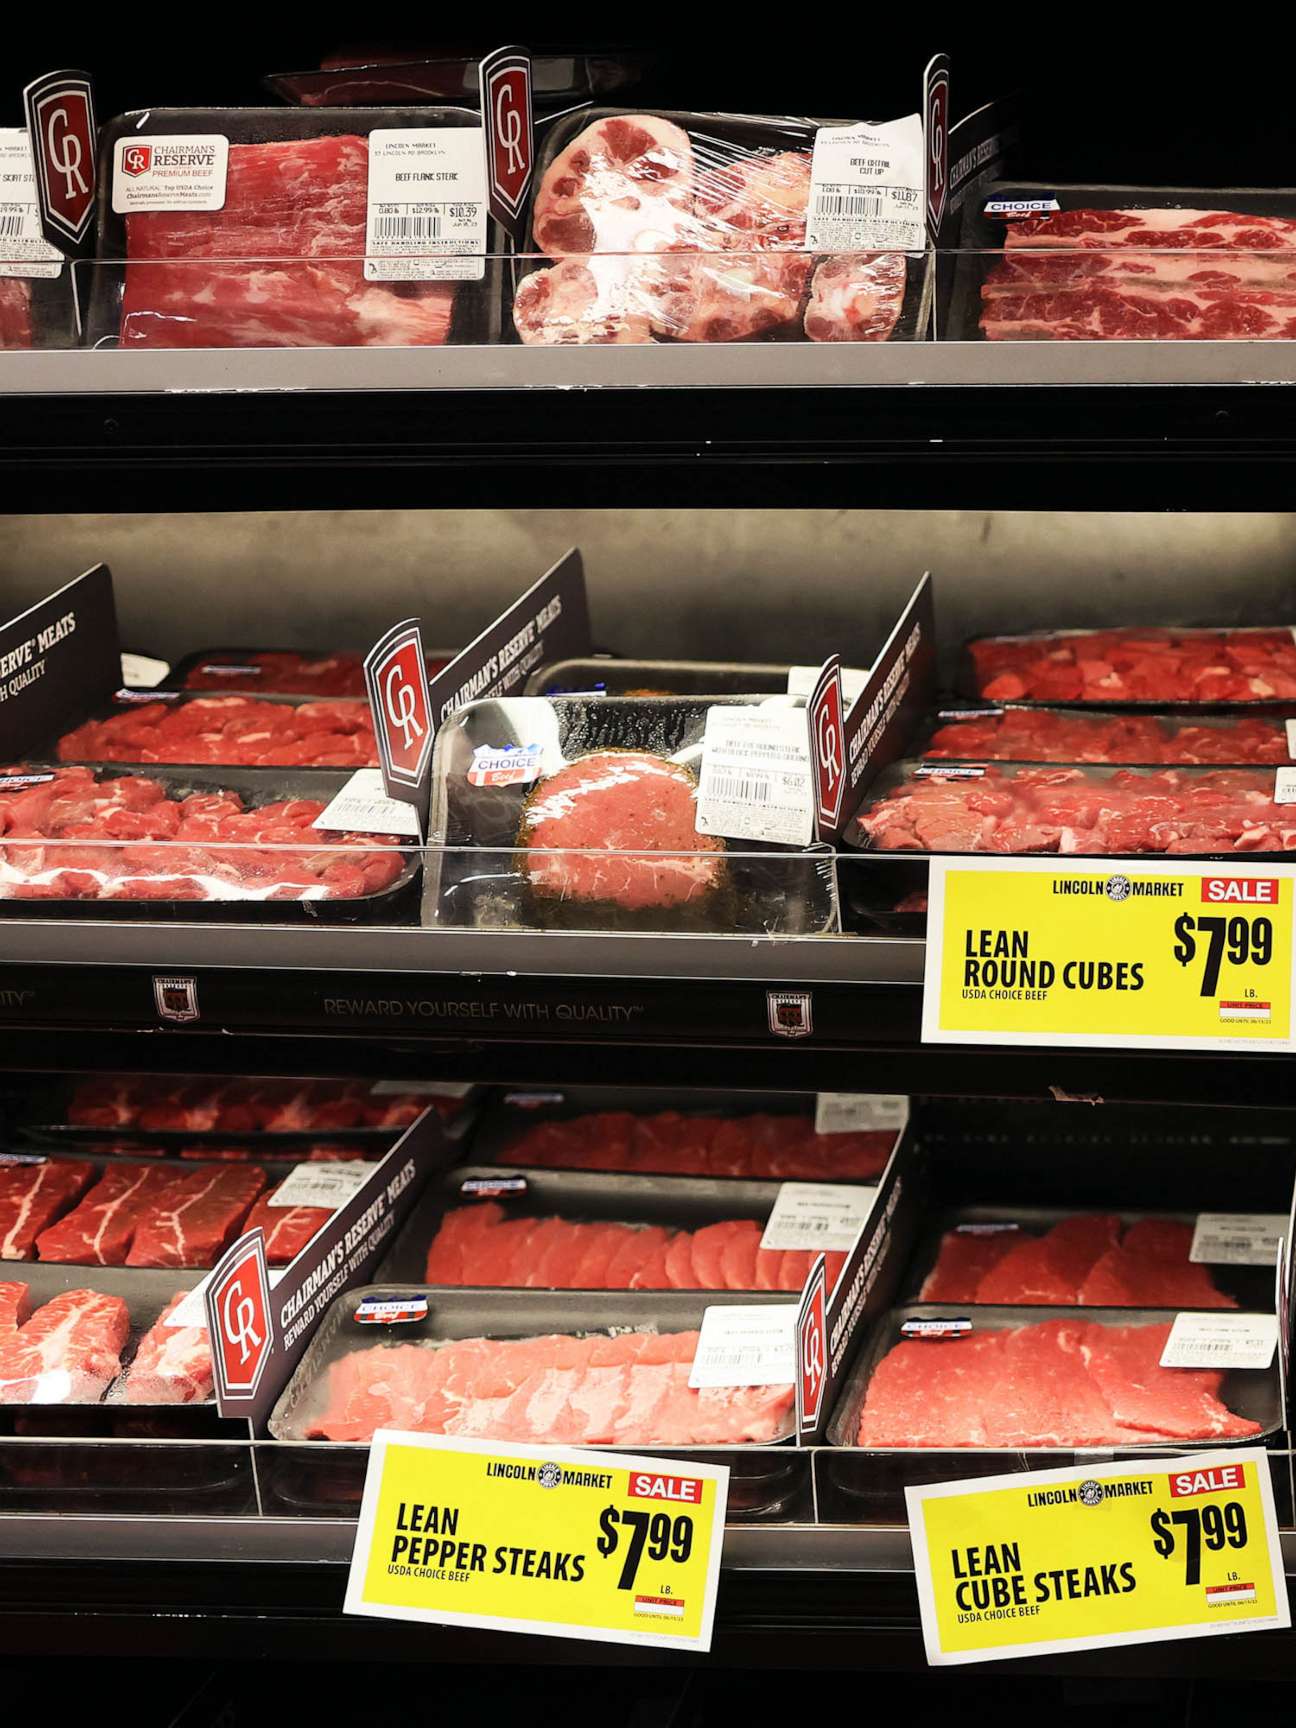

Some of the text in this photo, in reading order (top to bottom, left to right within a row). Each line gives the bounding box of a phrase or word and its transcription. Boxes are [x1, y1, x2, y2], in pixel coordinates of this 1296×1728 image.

[127, 149, 145, 169] CR
[153, 155, 216, 166] RESERVE
[154, 146, 215, 154] CHAIRMAN'S
[395, 173, 459, 181] BEEF FLANK STEAK
[450, 207, 477, 217] $10.39
[991, 202, 1052, 210] CHOICE
[37, 612, 76, 653] MEATS
[9, 659, 46, 697] QUALITY
[441, 656, 498, 722] CHAIRMAN'S
[479, 757, 536, 770] CHOICE
[1053, 880, 1104, 895] LINCOLN
[1132, 883, 1184, 897] MARKET
[1208, 880, 1272, 903] SALE
[965, 930, 1029, 958] LEAN
[964, 959, 1144, 991] ROUND CUBES
[962, 989, 1047, 1001] USDA CHOICE BEEF
[1244, 989, 1258, 998] LB.
[323, 999, 402, 1016] REWARD
[408, 1000, 499, 1017] YOURSELF
[504, 1002, 550, 1019] WITH
[280, 1158, 416, 1328] CHAIRMAN'S RESERVE MEATS
[284, 1306, 316, 1351] REWARD
[315, 1265, 350, 1317] YOURSELF
[349, 1242, 368, 1272] WITH
[487, 1462, 536, 1481] LINCOLN
[563, 1471, 613, 1489] MARKET
[1176, 1467, 1239, 1497] SALE
[635, 1475, 696, 1501] SALE
[1028, 1491, 1077, 1508] LINCOLN
[1104, 1480, 1153, 1497] MARKET
[396, 1502, 459, 1536] LEAN
[391, 1535, 586, 1582] PEPPER STEAKS
[951, 1542, 1021, 1579] LEAN
[387, 1564, 470, 1582] USDA CHOICE BEEF
[1227, 1571, 1240, 1581] LB.
[660, 1585, 673, 1595] LB.
[955, 1562, 1136, 1612] CUBE STEAKS
[958, 1605, 1040, 1623] USDA CHOICE BEEF
